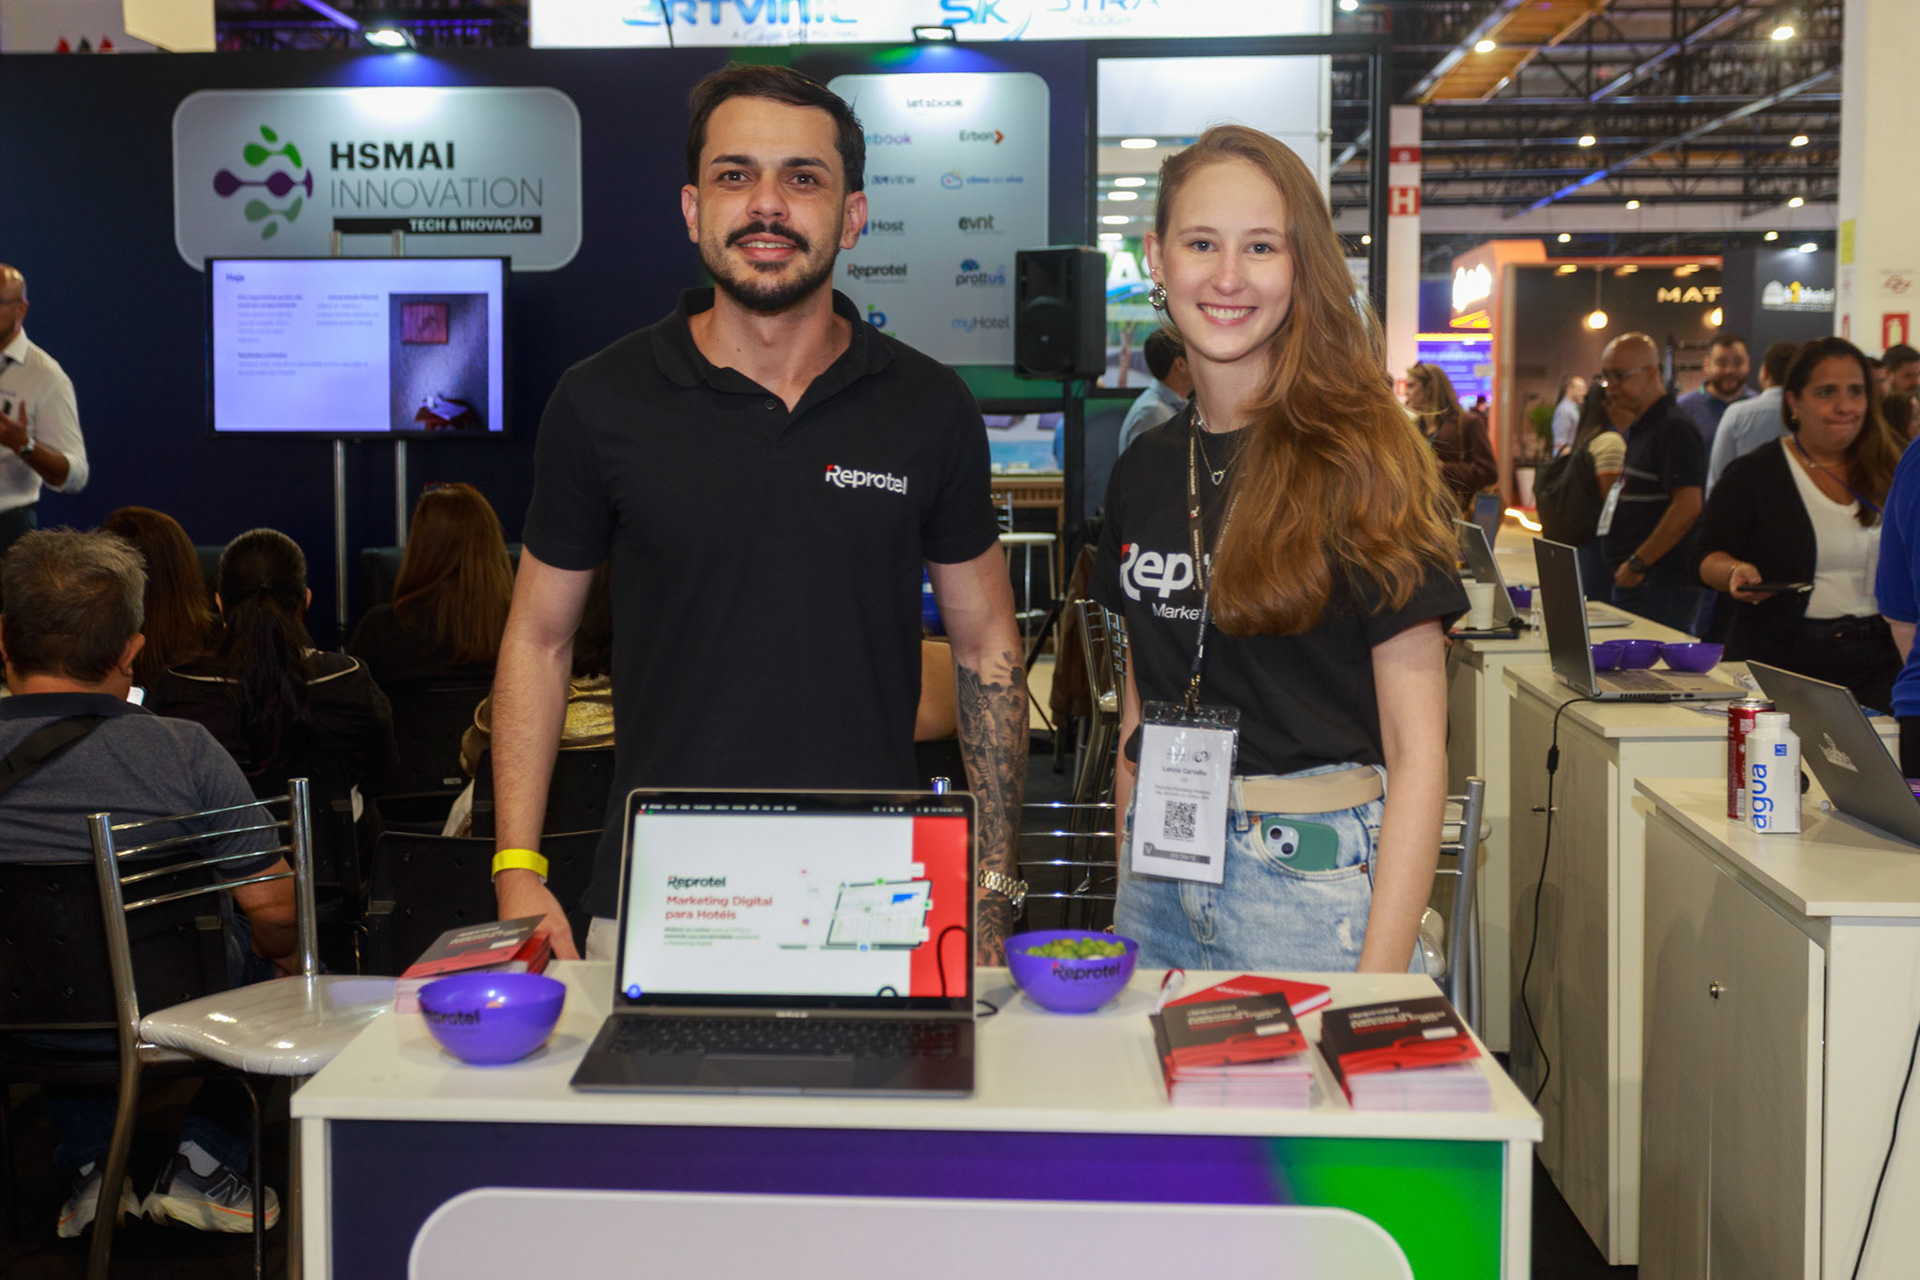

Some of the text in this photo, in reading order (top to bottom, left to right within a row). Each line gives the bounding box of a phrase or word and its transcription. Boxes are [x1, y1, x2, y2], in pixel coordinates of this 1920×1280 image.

[959, 130, 994, 142] Erbon
[330, 142, 455, 170] HSMAI
[331, 177, 543, 209] INNOVATION
[1391, 189, 1416, 214] H
[409, 216, 533, 235] TECH & INOVAÇÃO
[871, 220, 904, 231] Host
[847, 263, 907, 280] Reprotel
[952, 317, 1009, 333] myHotel
[825, 464, 908, 495] Reprotel
[1120, 543, 1210, 601] Rep
[1152, 603, 1201, 620] Marke
[667, 876, 726, 890] Reprotel
[667, 896, 772, 907] Marketing Digital
[665, 911, 693, 921] para
[1053, 962, 1121, 981] Reprotel
